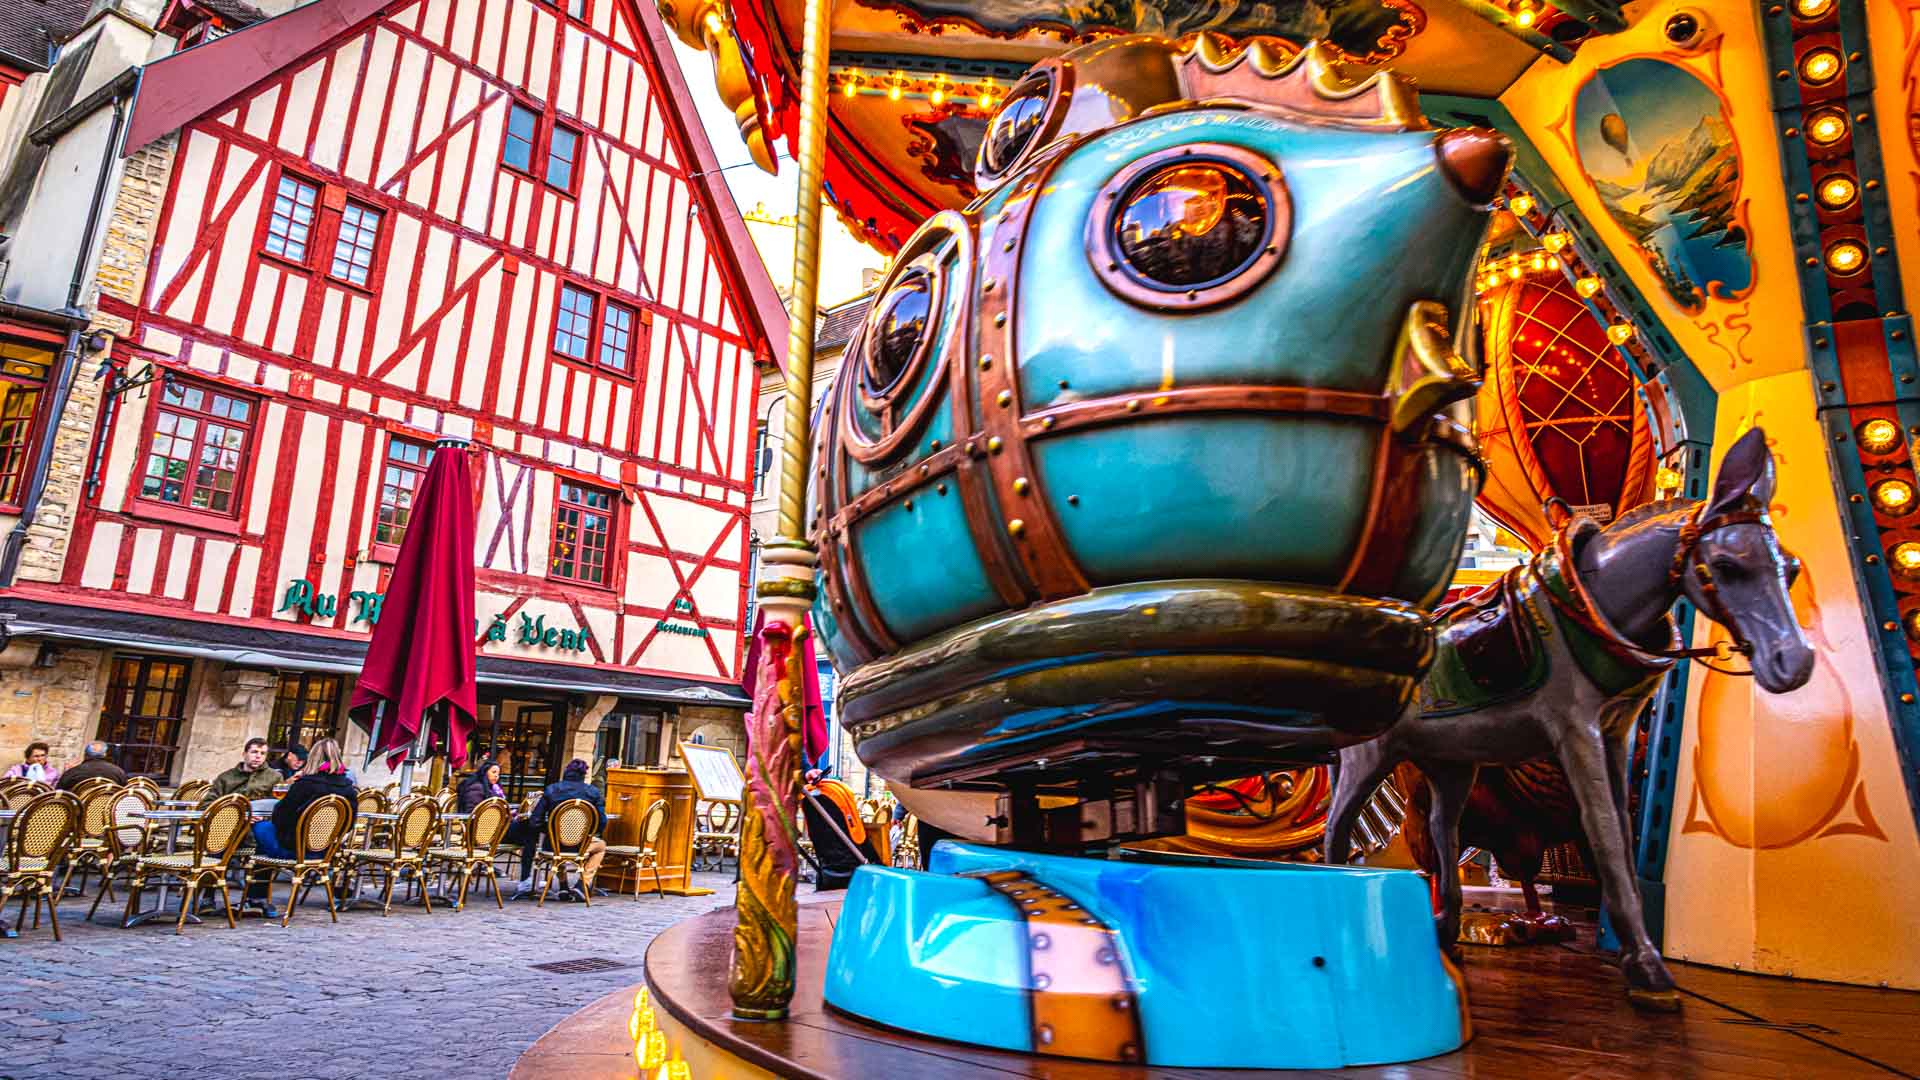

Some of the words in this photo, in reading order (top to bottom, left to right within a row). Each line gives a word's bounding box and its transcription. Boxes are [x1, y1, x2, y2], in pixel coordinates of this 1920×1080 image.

[277, 579, 337, 617] Au
[487, 613, 506, 641] à
[518, 611, 589, 652] Vent
